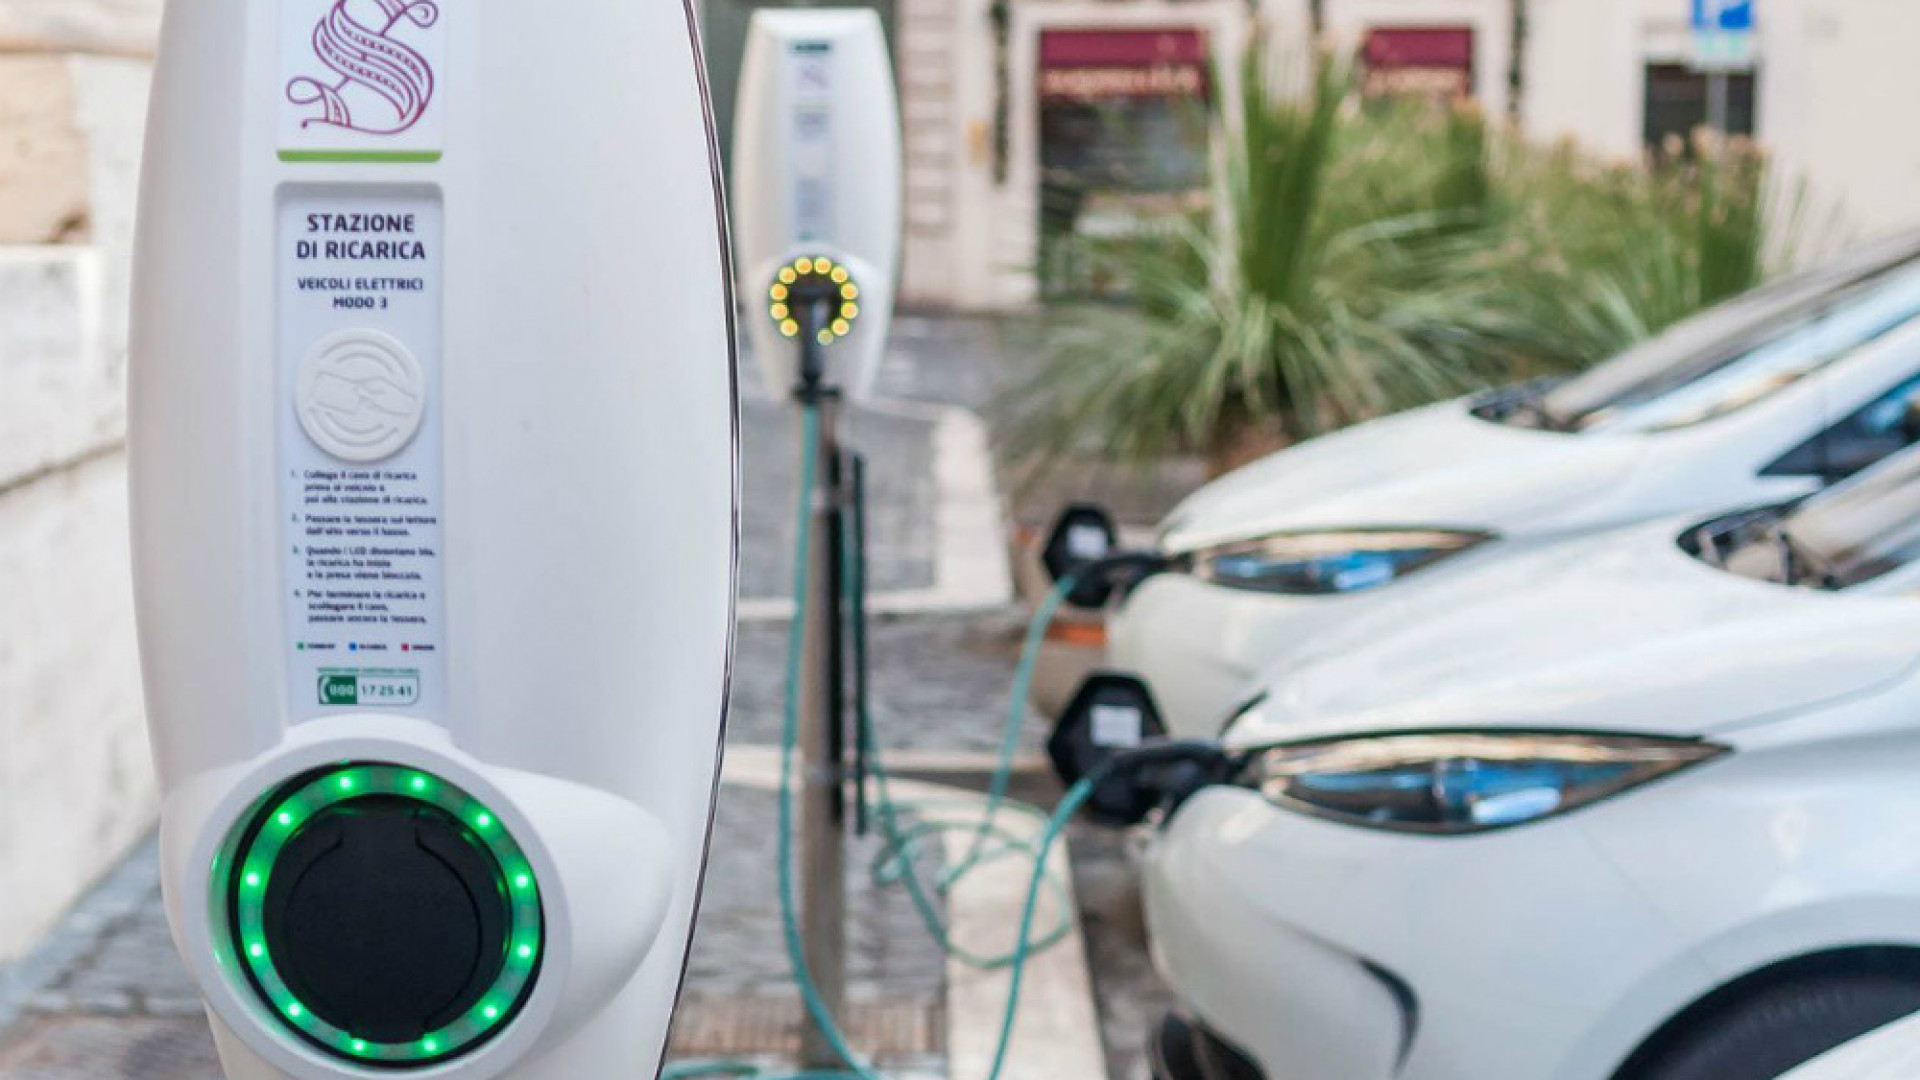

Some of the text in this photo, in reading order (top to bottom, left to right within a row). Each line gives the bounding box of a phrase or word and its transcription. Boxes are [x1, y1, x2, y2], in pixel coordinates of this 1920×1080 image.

[306, 213, 416, 233] STAZIONE
[296, 240, 426, 260] DI RICARICA
[298, 277, 423, 291] VEICOLI ELETTRICI
[333, 296, 388, 309] MODO 3
